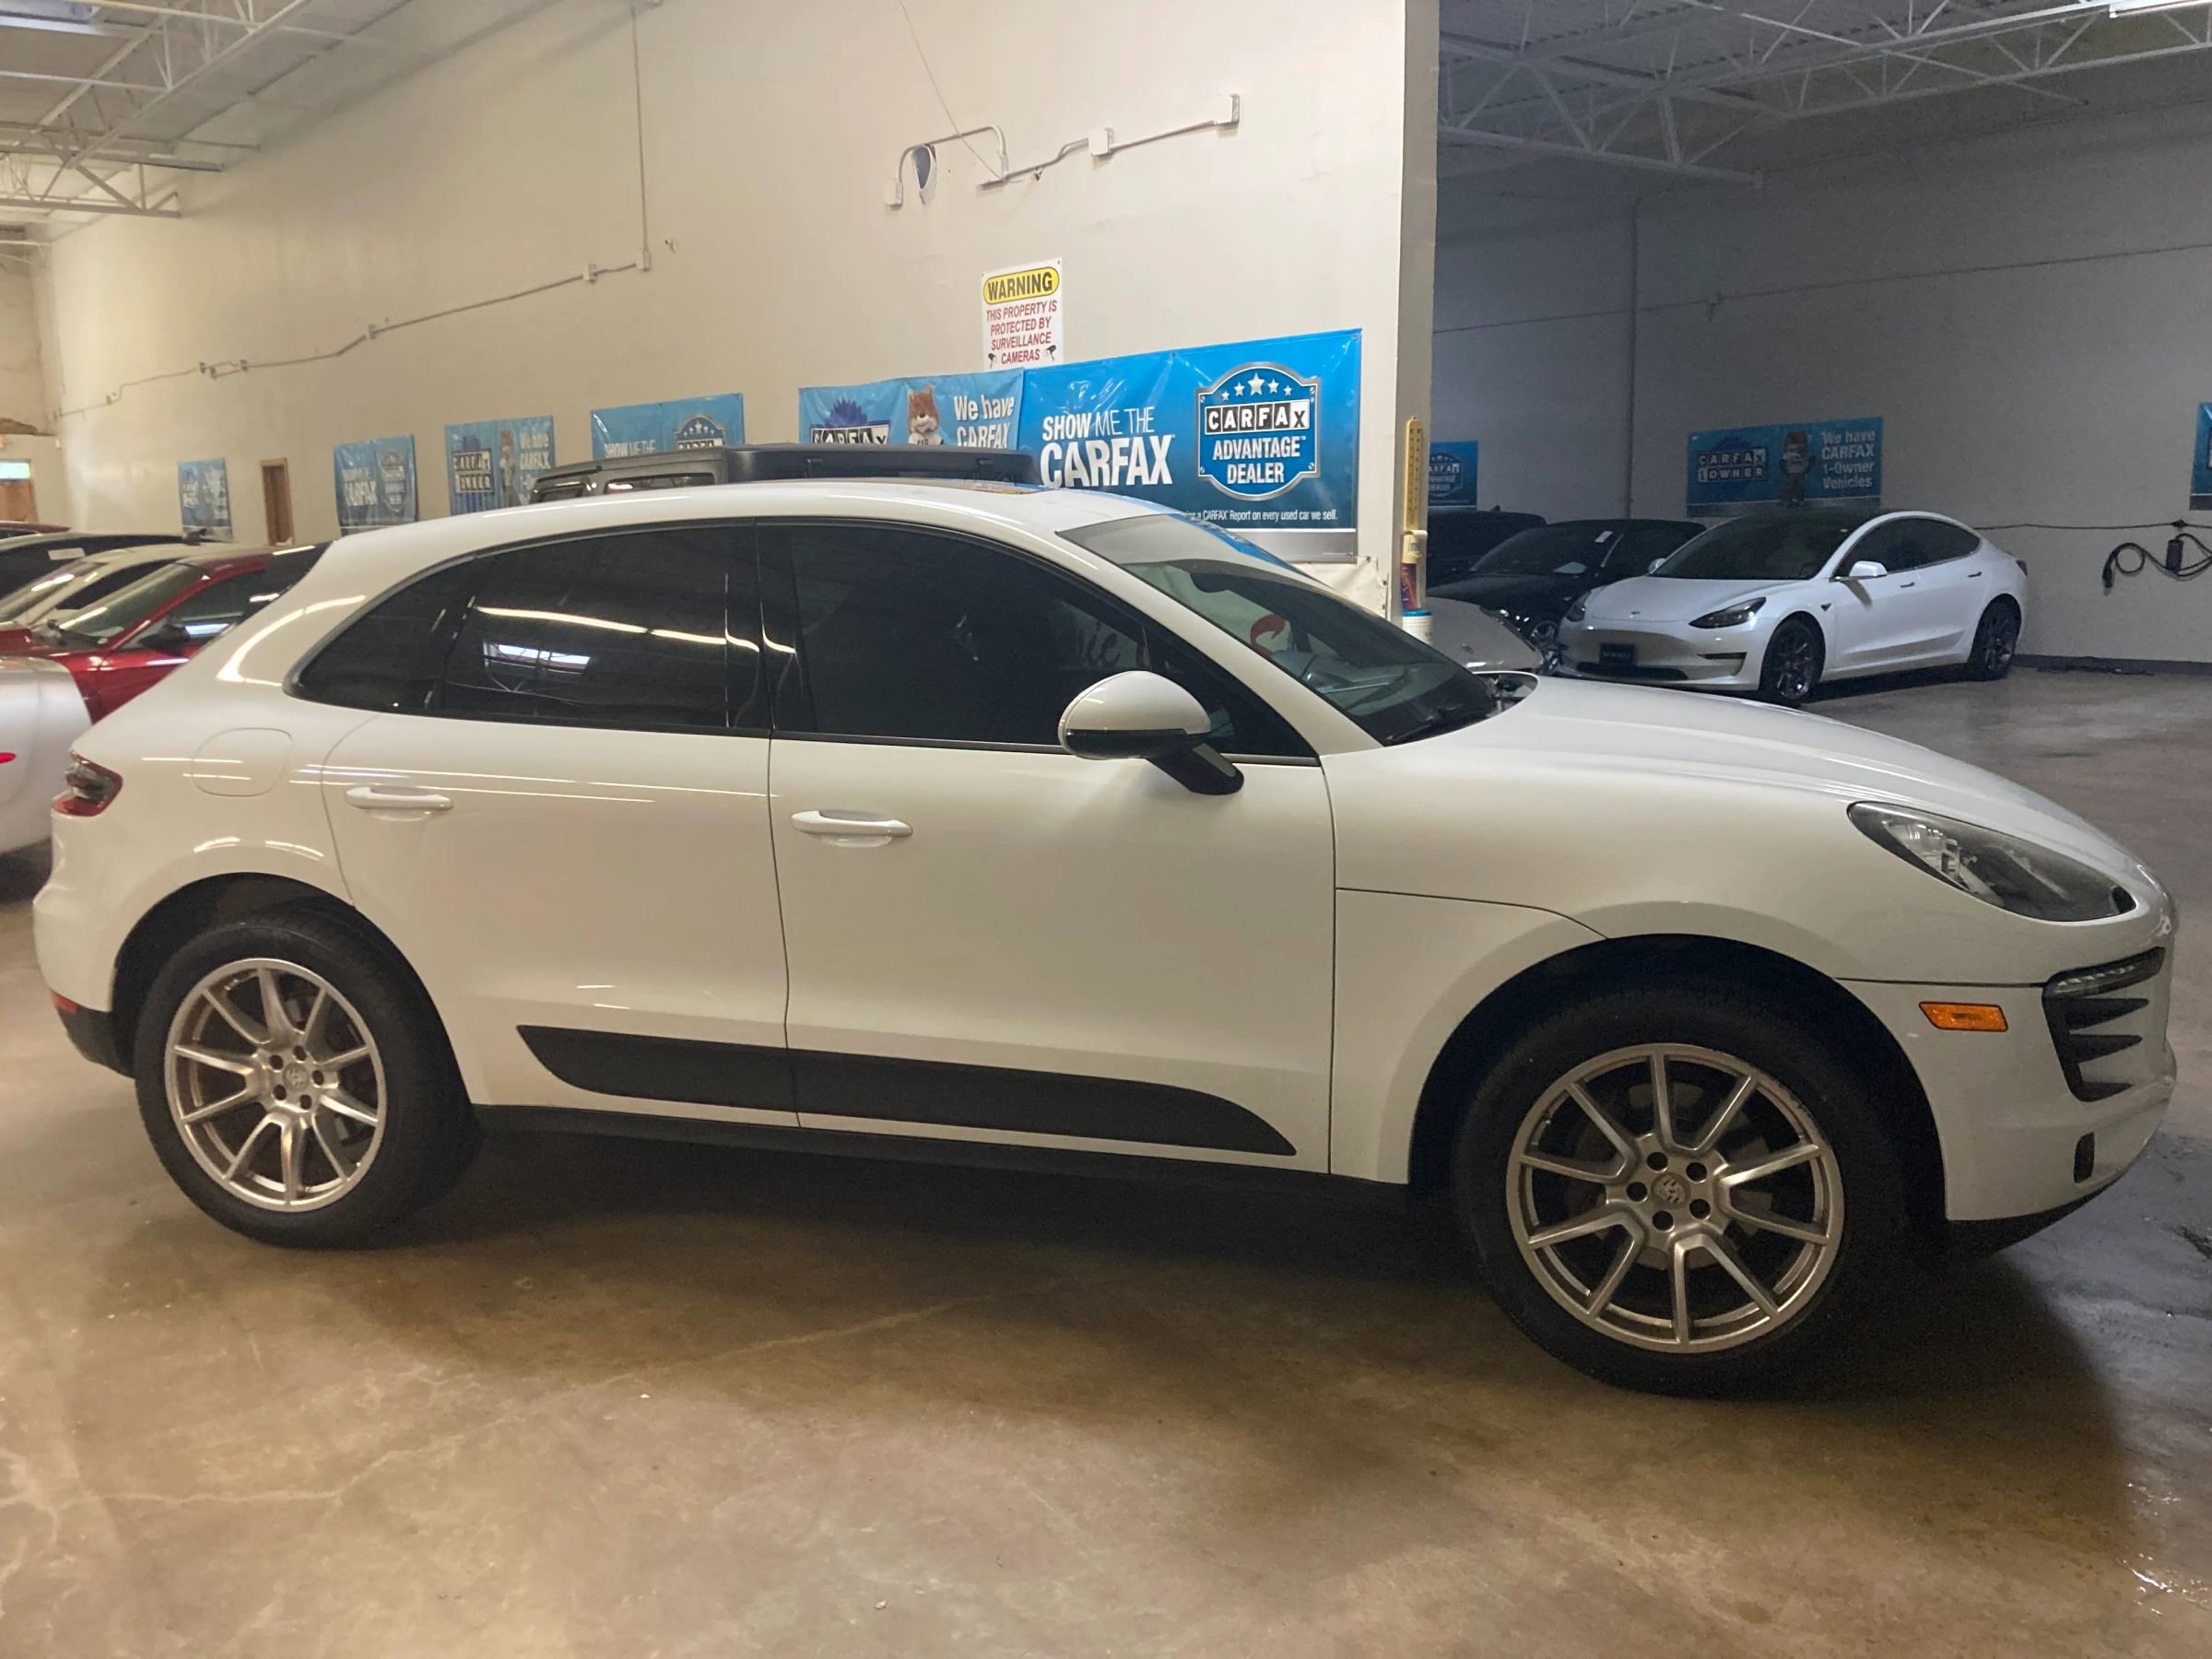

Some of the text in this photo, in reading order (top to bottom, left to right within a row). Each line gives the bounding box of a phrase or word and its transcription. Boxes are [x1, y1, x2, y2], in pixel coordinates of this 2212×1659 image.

[988, 272, 1053, 300] WARNING
[986, 300, 1058, 322] THIS PROPERTY IS
[991, 316, 1053, 336] PROTECTED BY
[991, 332, 1052, 351] SURVEILLANCE
[1001, 348, 1041, 364] CAMERAS
[954, 394, 1015, 421] We have
[1207, 405, 1307, 431] CARFAX
[1042, 406, 1155, 441] SHOW ME THE
[957, 422, 1011, 449] CARFAX
[1844, 429, 1876, 442] have
[1041, 434, 1173, 488] CARFAX
[1821, 442, 1875, 460] CARFAX
[1227, 462, 1285, 485] DEALER
[1822, 461, 1875, 476] 1-Owner
[1821, 476, 1873, 489] Vehicles
[1203, 510, 1228, 521] CARFAX
[1230, 510, 1251, 522] Report
[1252, 512, 1262, 521] on
[1263, 512, 1279, 523] every
[1280, 510, 1298, 521] used
[1299, 511, 1310, 521] car
[1311, 511, 1322, 521] we
[1323, 509, 1338, 520] sell.
